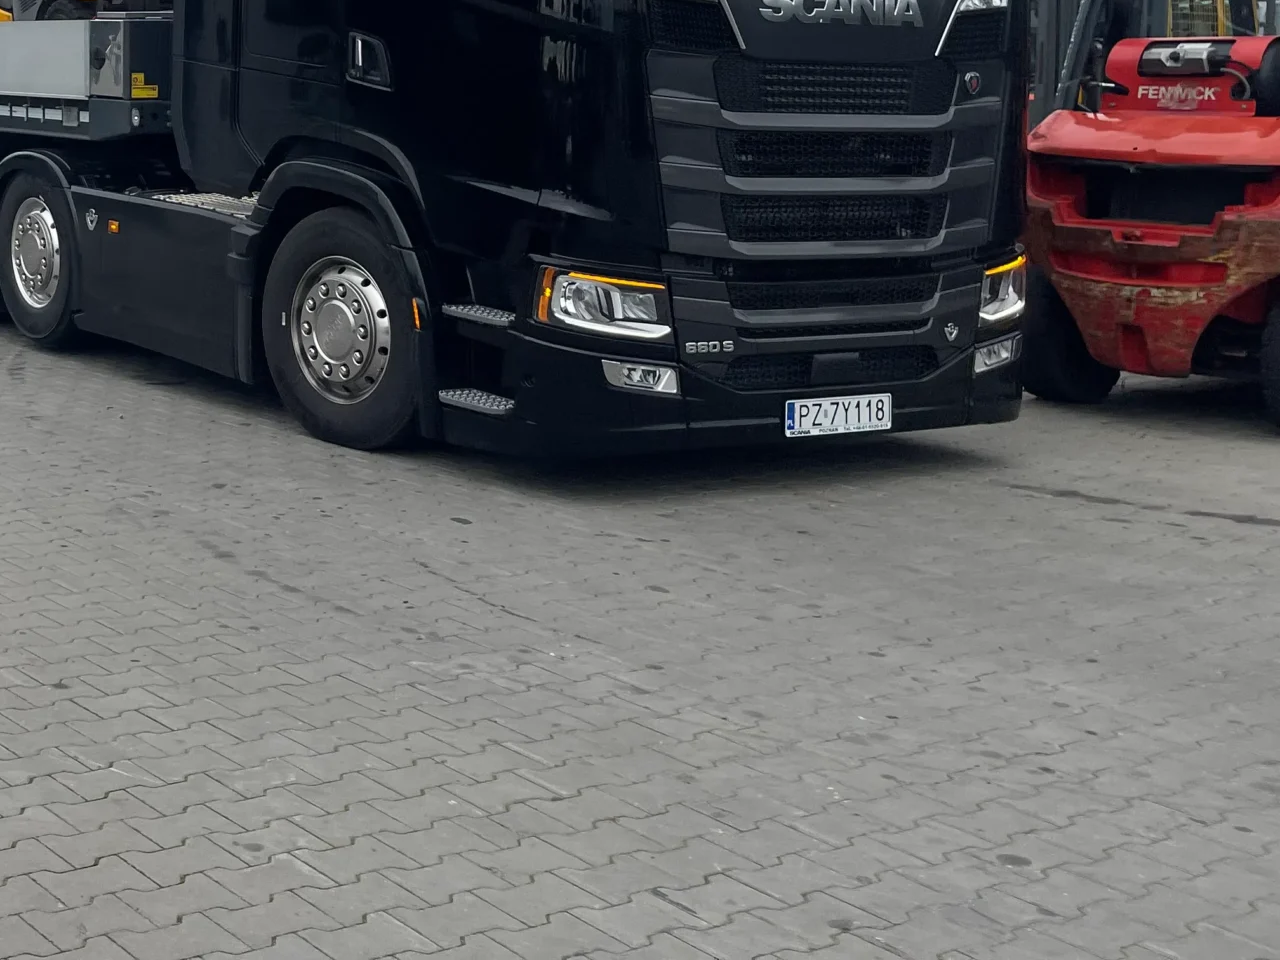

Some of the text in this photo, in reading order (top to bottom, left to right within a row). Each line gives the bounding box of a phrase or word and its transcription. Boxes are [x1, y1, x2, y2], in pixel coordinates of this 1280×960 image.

[1137, 85, 1216, 101] FENWICK
[685, 340, 735, 354] 660 S
[799, 403, 823, 428] PZ
[830, 399, 885, 426] 7Y118
